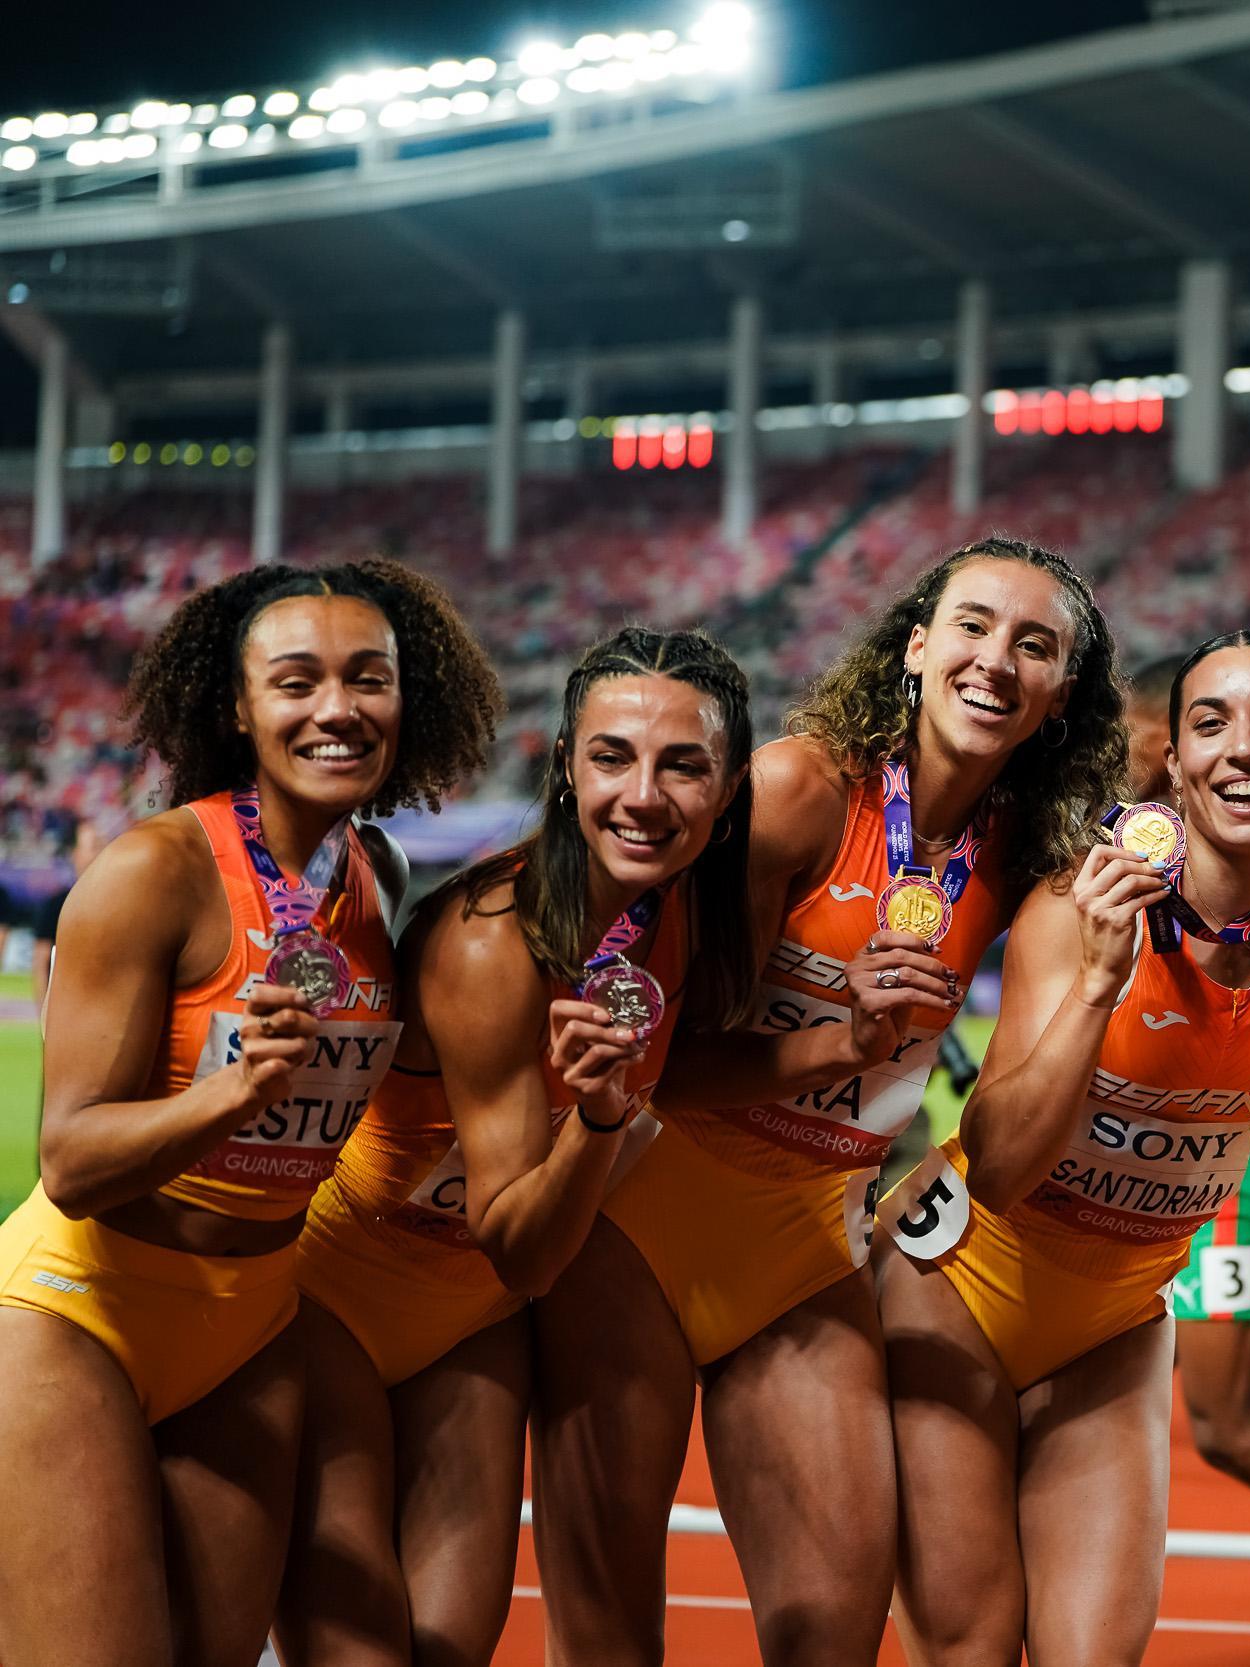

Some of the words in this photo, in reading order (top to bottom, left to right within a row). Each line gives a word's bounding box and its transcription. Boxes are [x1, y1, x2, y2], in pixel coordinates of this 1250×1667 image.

[748, 1105, 867, 1157] GUANGZHOU
[1088, 1111, 1242, 1162] SONY
[896, 1176, 955, 1239] 5
[1050, 1159, 1235, 1217] SANTIDRIÁN
[1076, 1209, 1192, 1239] GUANGZHOU
[31, 1270, 90, 1294] ESP
[1223, 1259, 1244, 1299] 3
